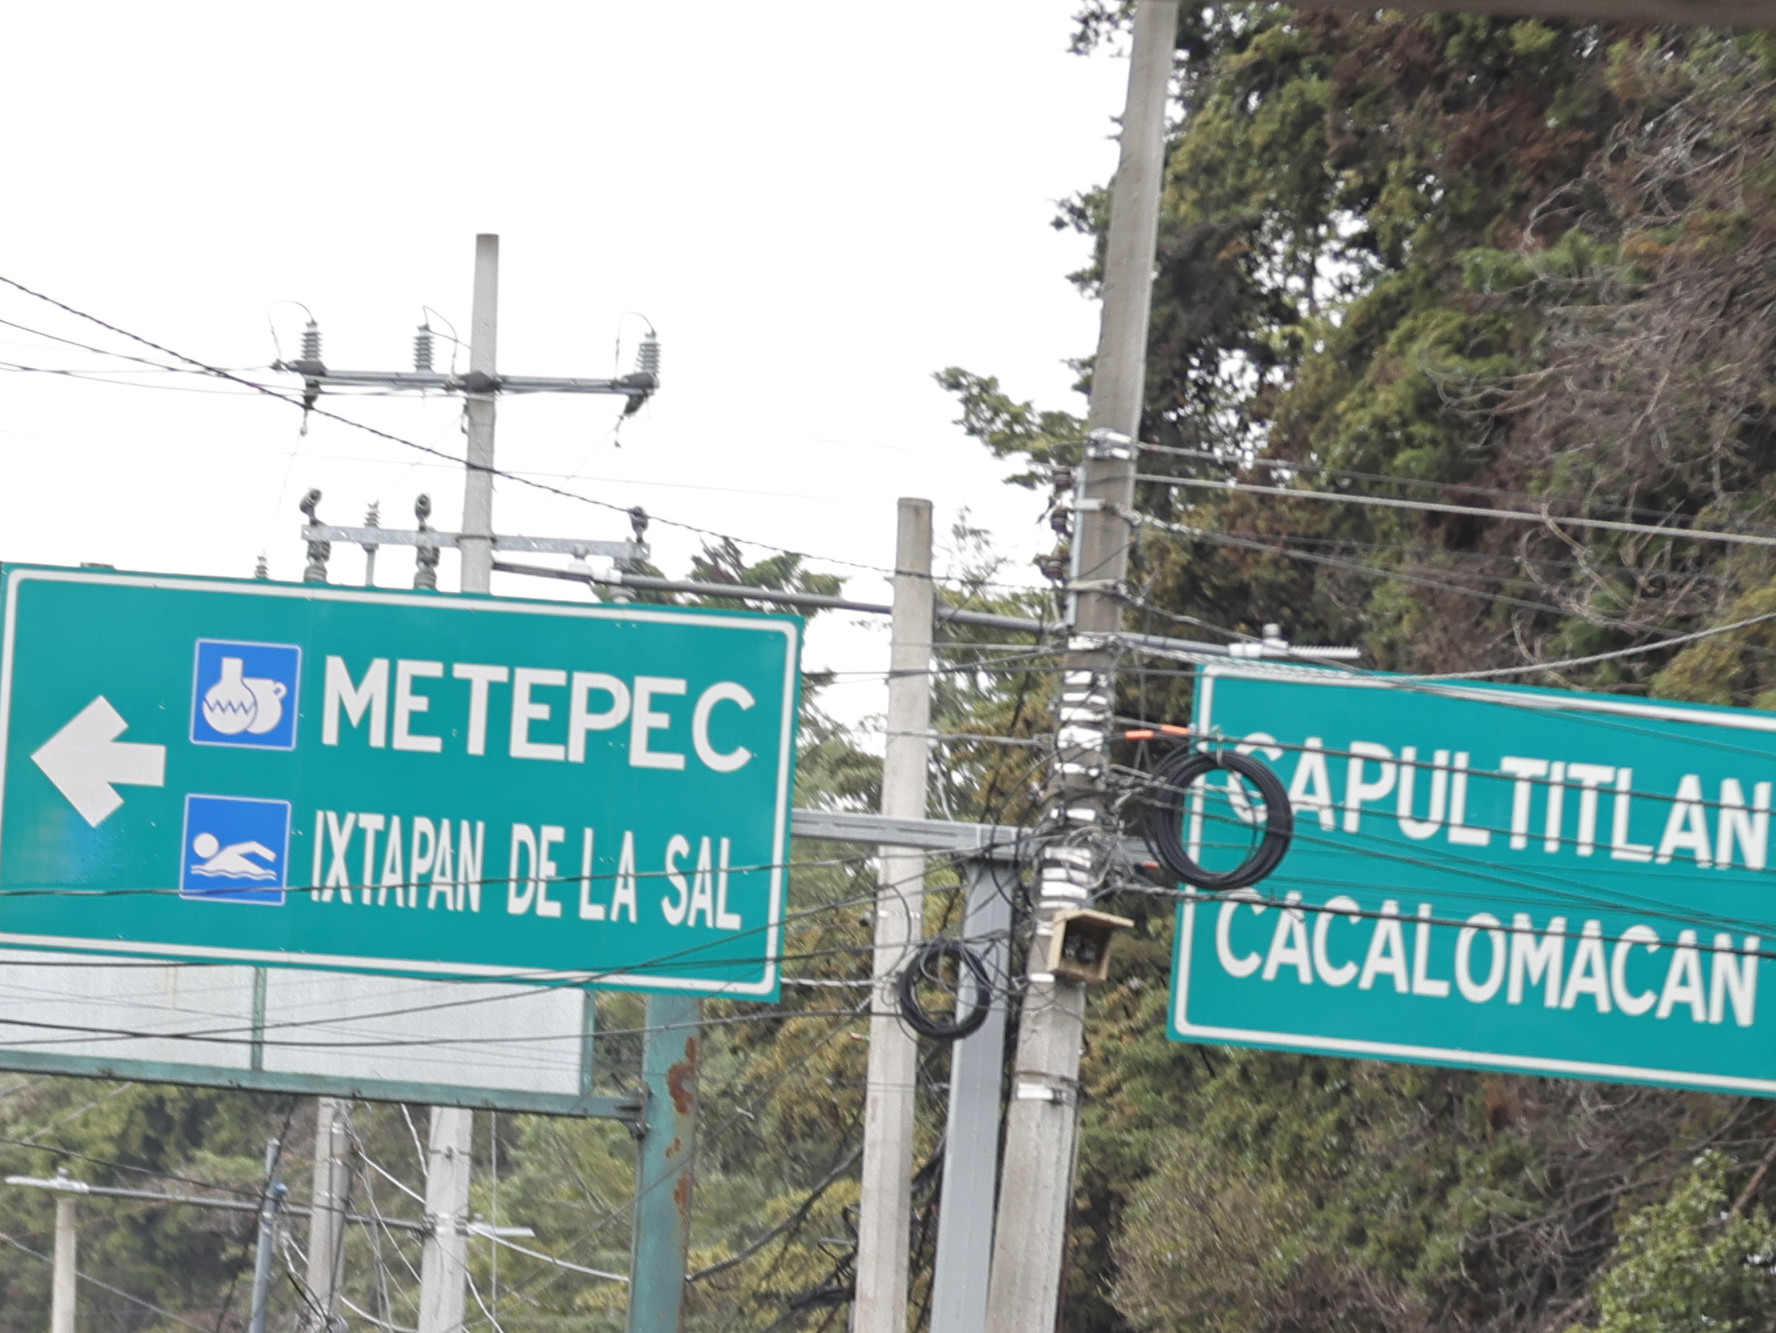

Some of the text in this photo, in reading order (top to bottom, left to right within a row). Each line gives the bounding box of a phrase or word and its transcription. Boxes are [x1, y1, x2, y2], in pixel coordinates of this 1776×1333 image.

[321, 654, 756, 774] METEPEC
[311, 809, 742, 930] IXTAPAN DE LA SAL
[1216, 887, 1760, 1028] CACALOMACAN
